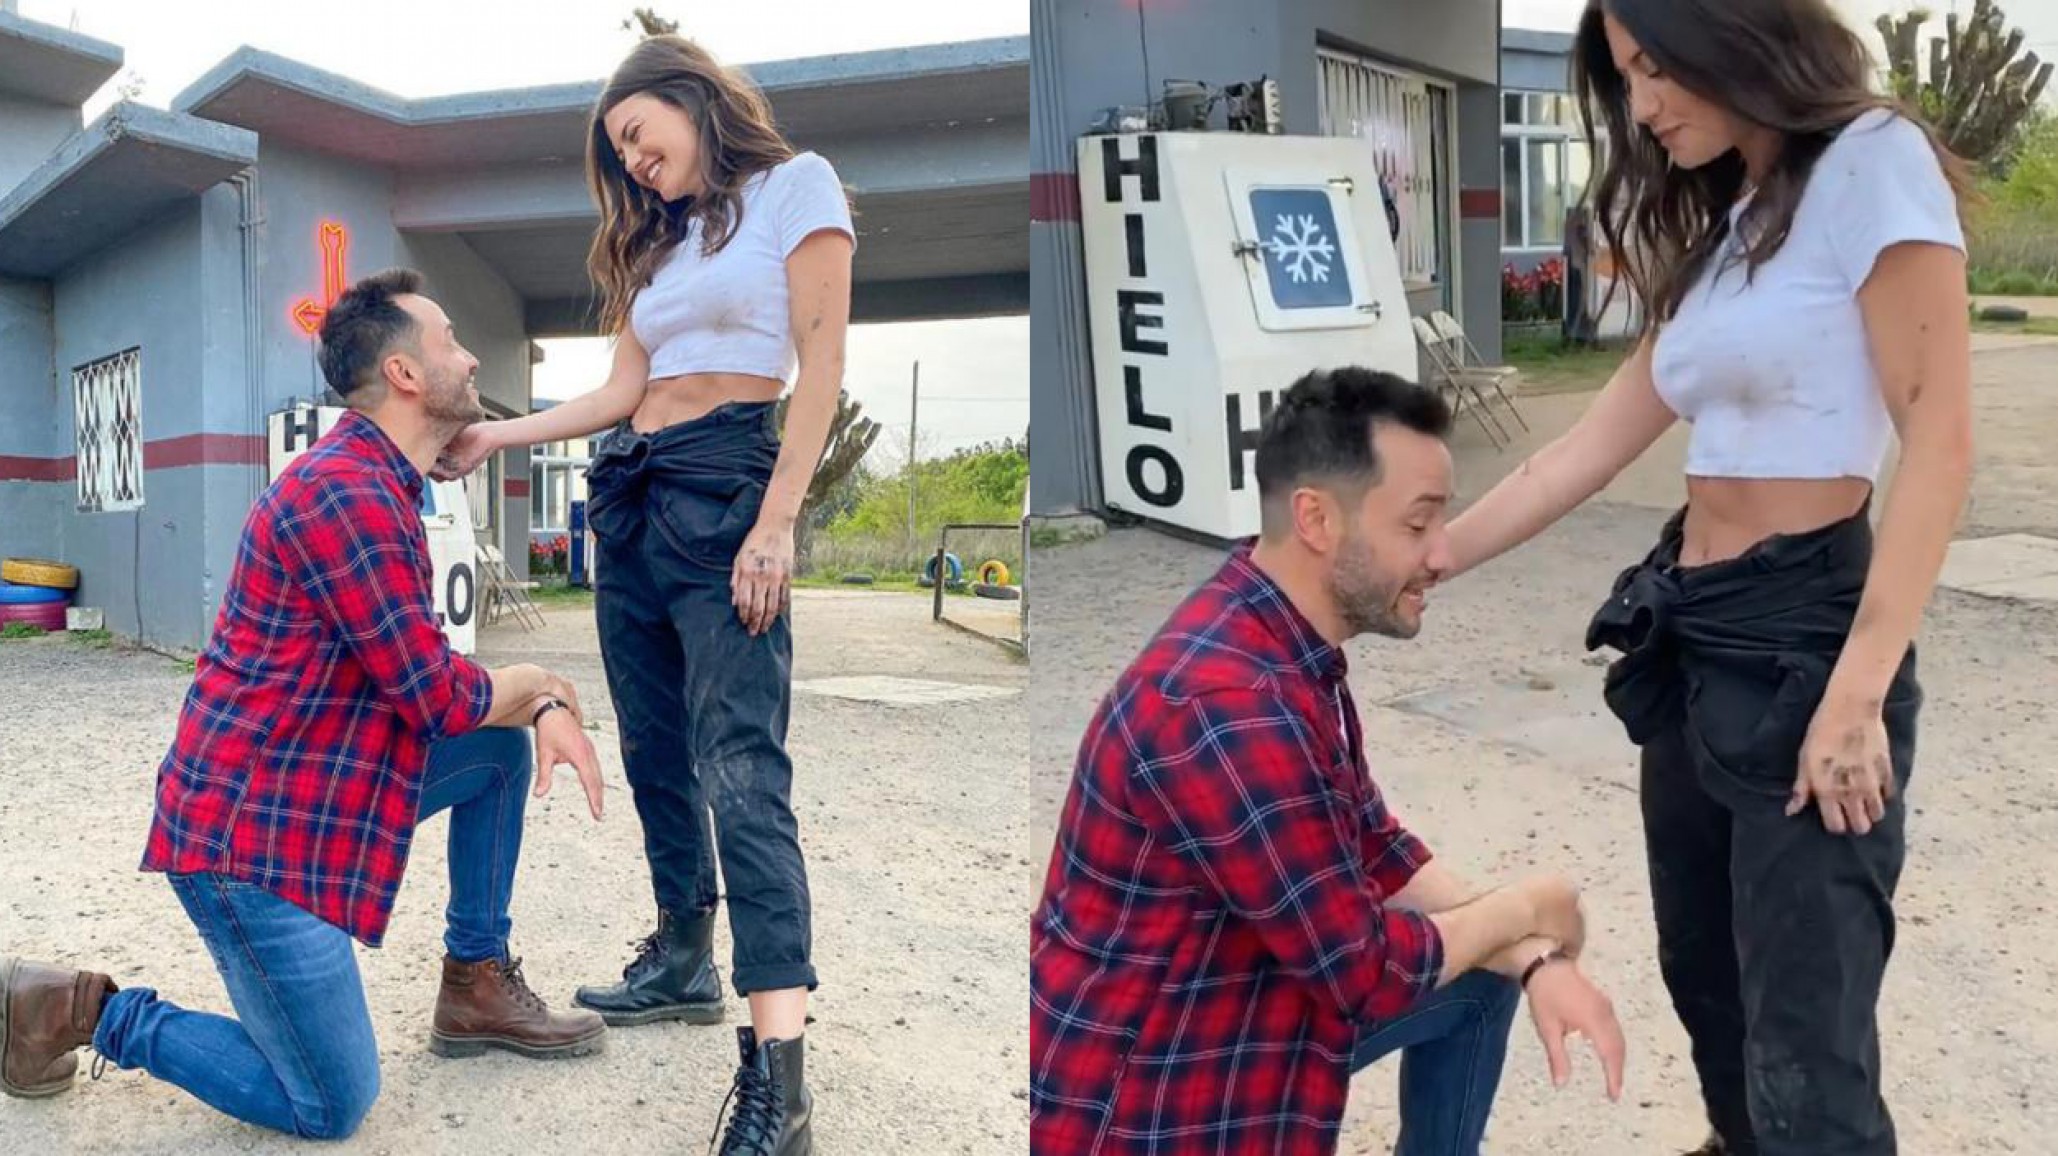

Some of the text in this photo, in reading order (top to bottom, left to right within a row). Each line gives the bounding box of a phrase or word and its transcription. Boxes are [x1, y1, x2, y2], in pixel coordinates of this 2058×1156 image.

[1102, 135, 1184, 507] HIELO
[1226, 390, 1290, 490] H
[437, 563, 474, 626] O
